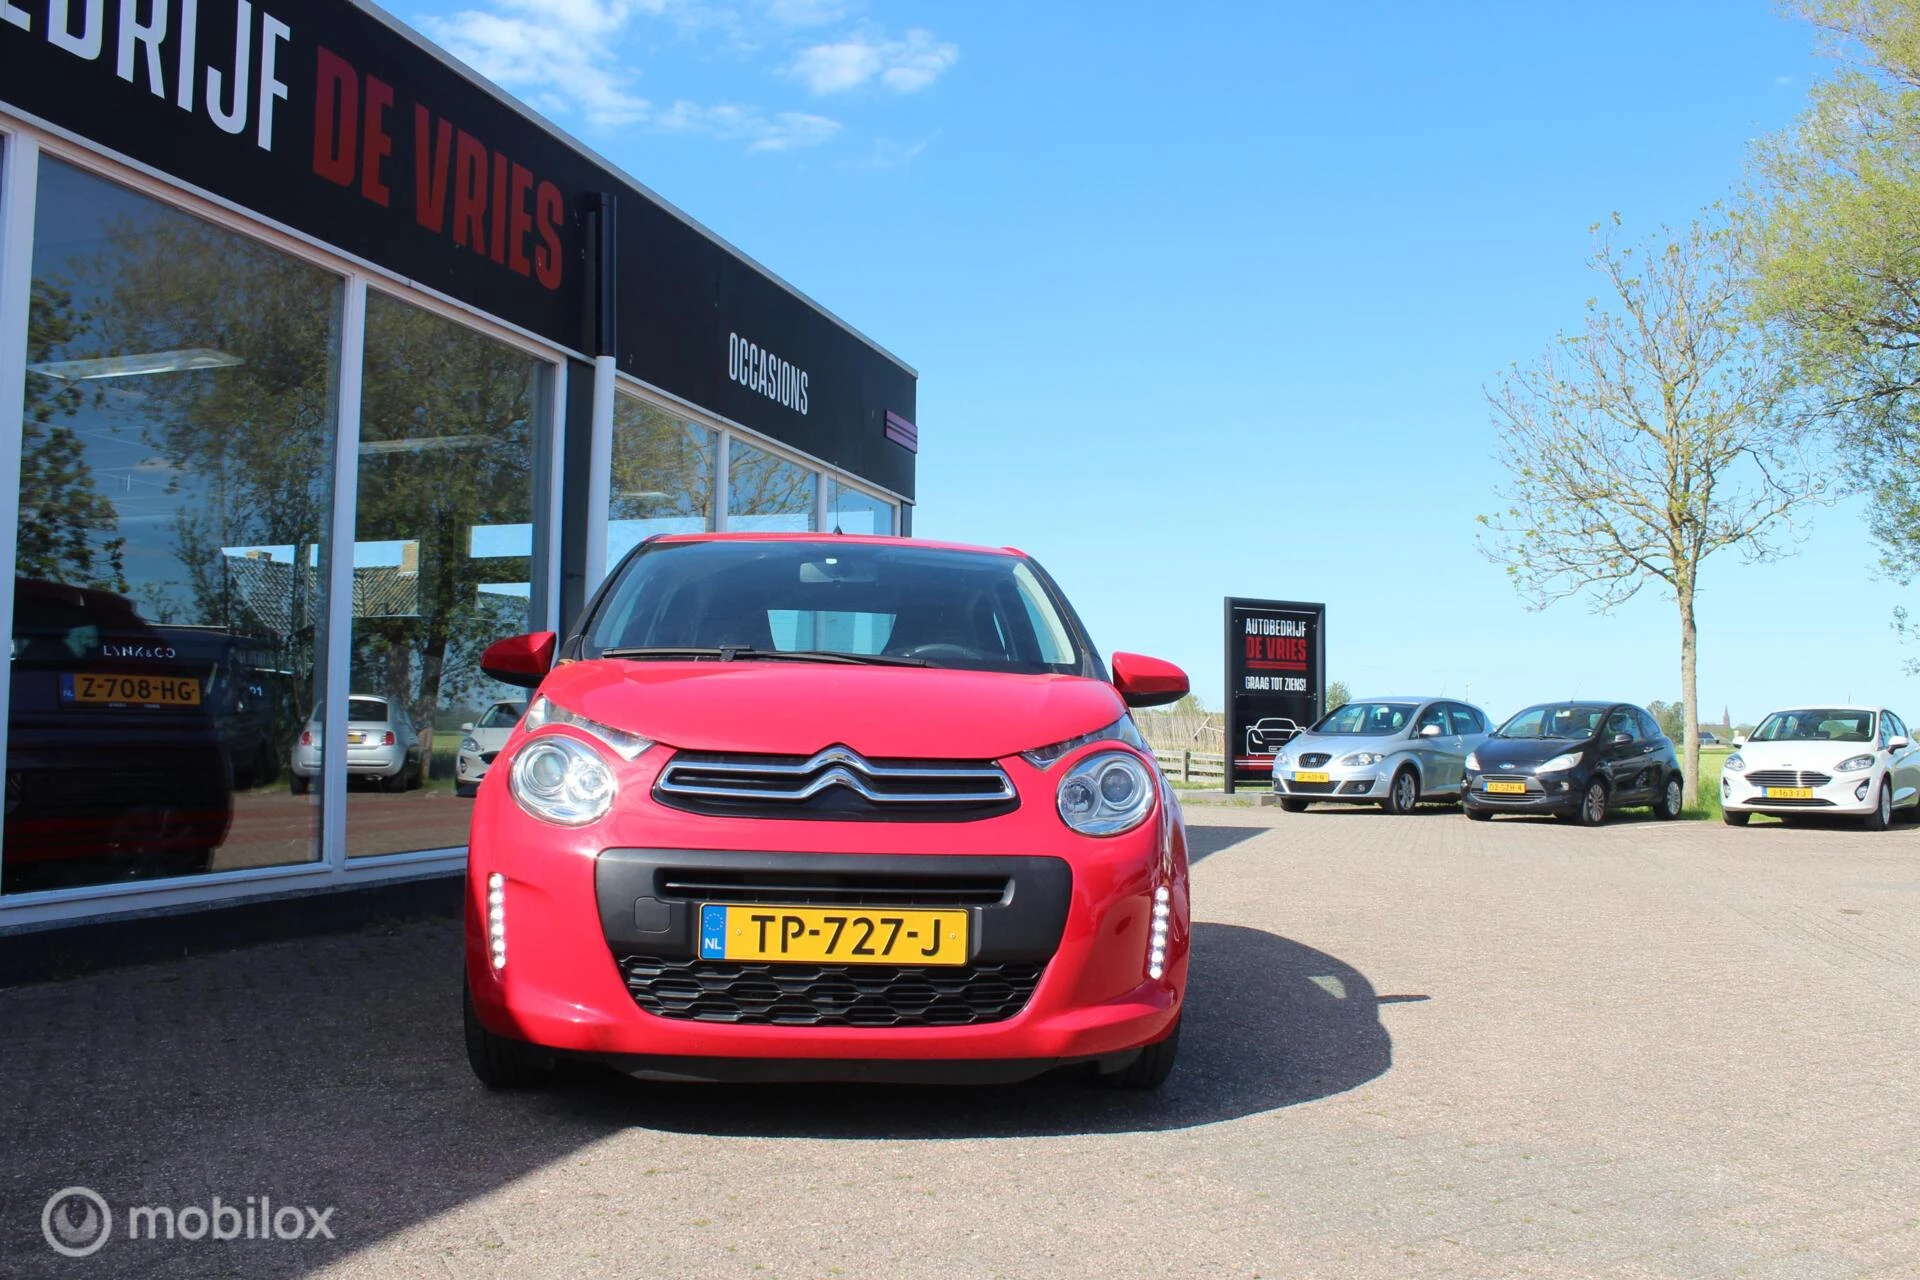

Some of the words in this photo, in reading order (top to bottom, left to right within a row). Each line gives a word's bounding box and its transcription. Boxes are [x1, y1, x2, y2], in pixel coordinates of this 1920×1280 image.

[312, 45, 395, 208] DE
[415, 102, 564, 290] VRIES
[729, 332, 809, 415] OCCASIONS
[1245, 618, 1306, 636] AUTOBEDRIJF
[1246, 636, 1262, 658] DE
[1266, 637, 1307, 661] VRIES
[82, 678, 192, 701] Z-708-HG
[1245, 676, 1270, 690] GRAAG
[1270, 677, 1283, 691] TOT
[1284, 678, 1307, 692] ZIENS!
[704, 938, 722, 950] NL
[751, 914, 941, 957] TP-727-J
